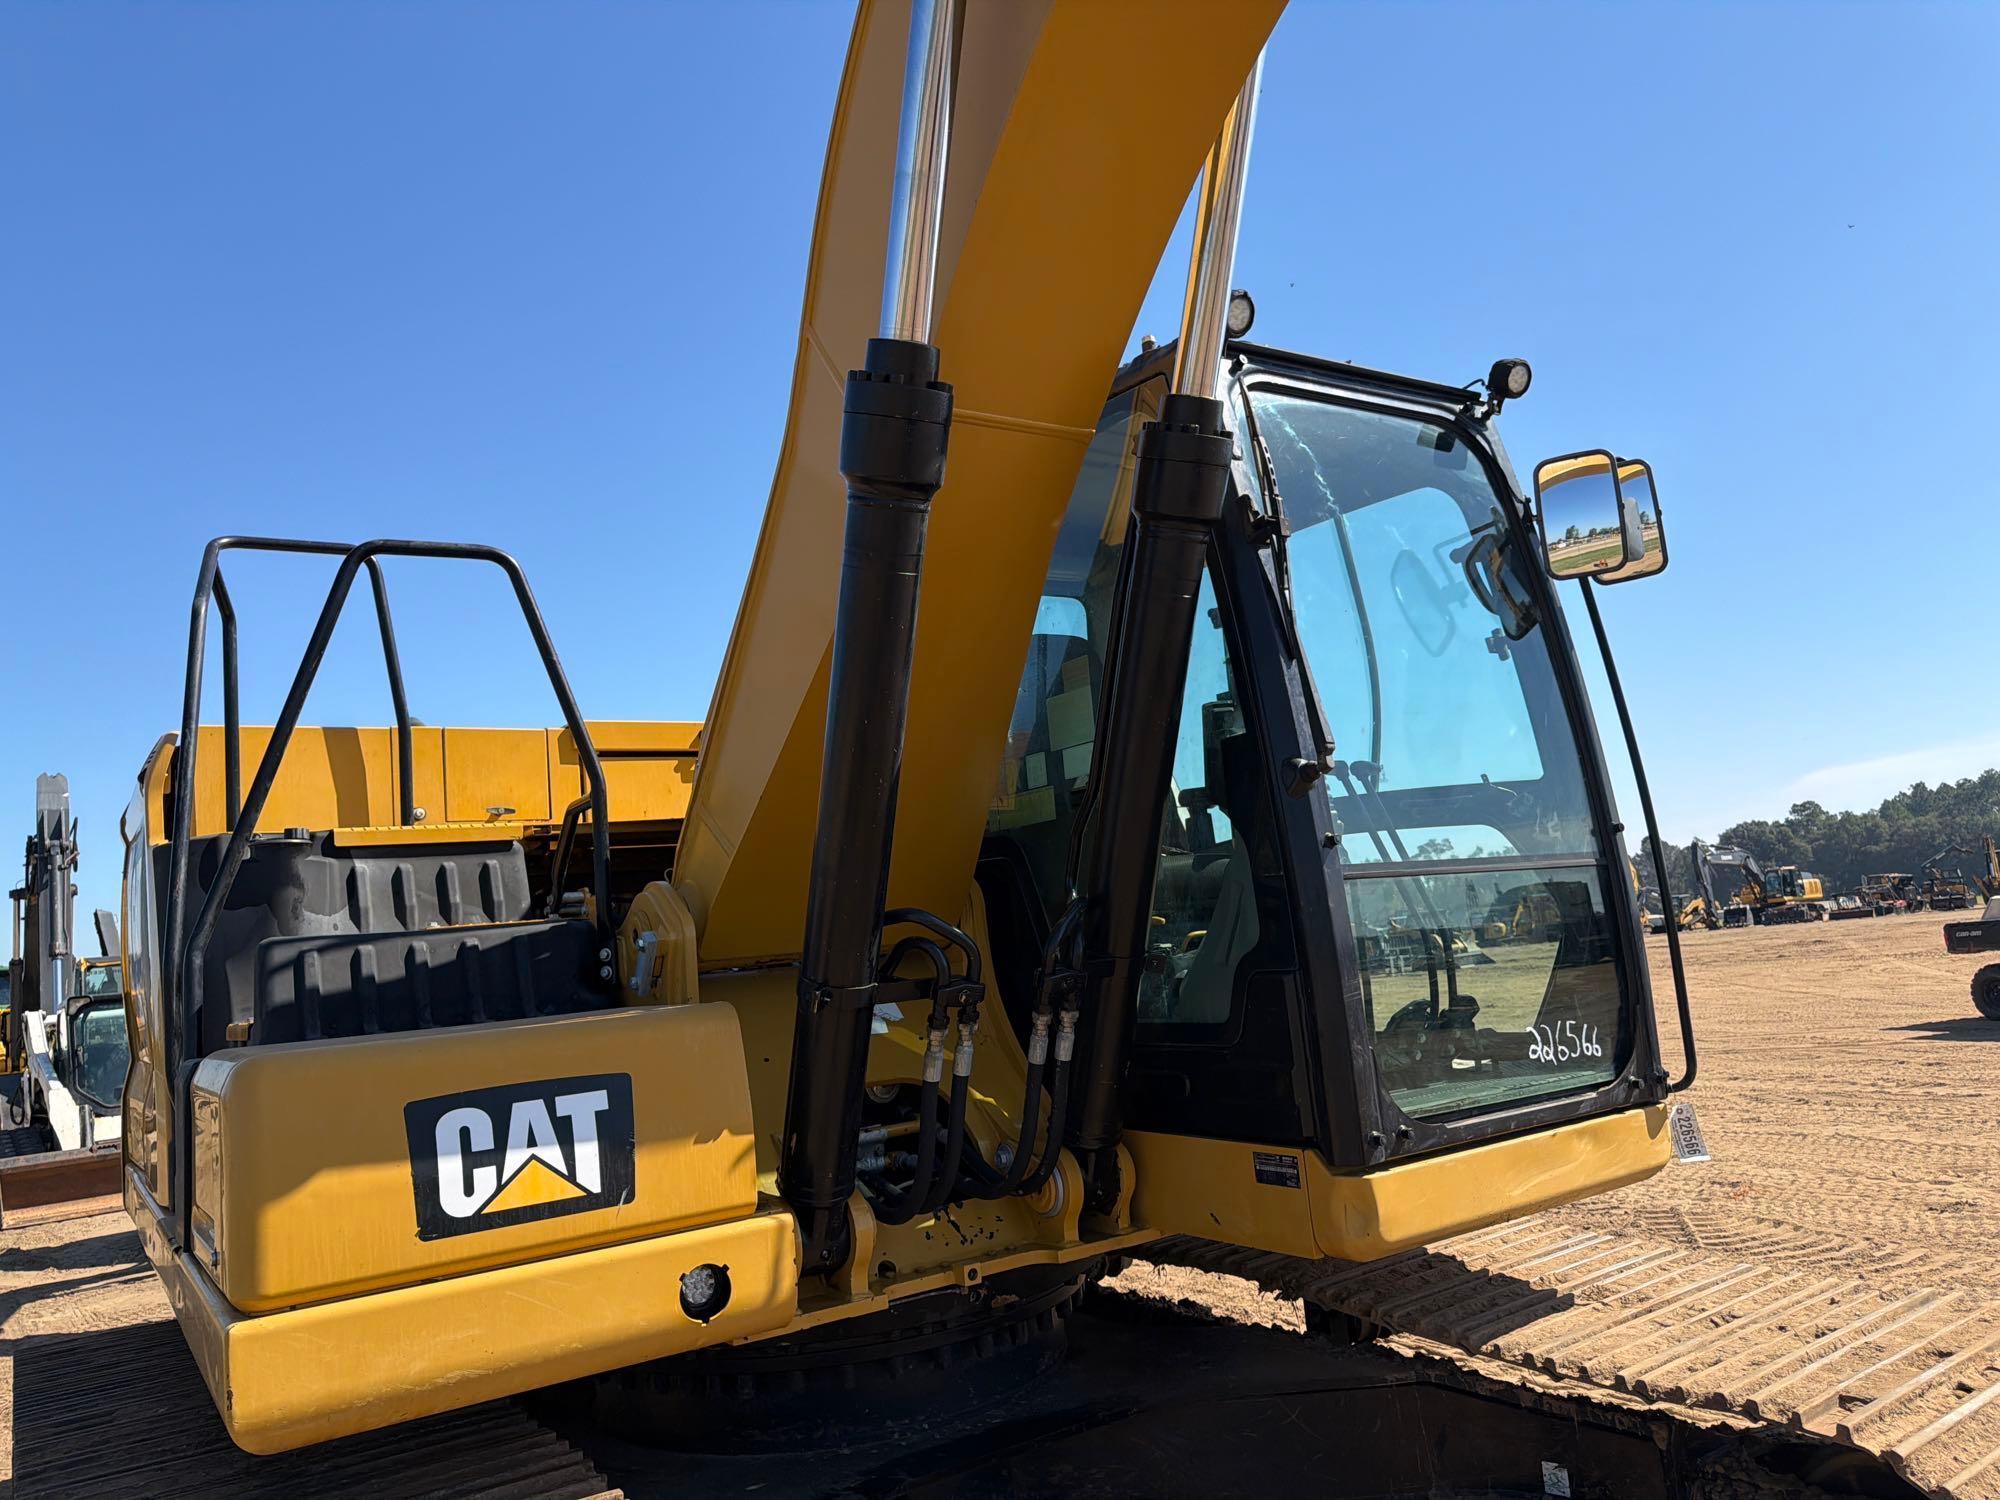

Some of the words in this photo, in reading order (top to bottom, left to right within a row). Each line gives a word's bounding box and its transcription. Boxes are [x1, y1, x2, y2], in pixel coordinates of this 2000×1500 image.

[1526, 1020, 1602, 1066] 226566
[435, 1089, 609, 1218] CAT
[1677, 1116, 1701, 1155] 226566
